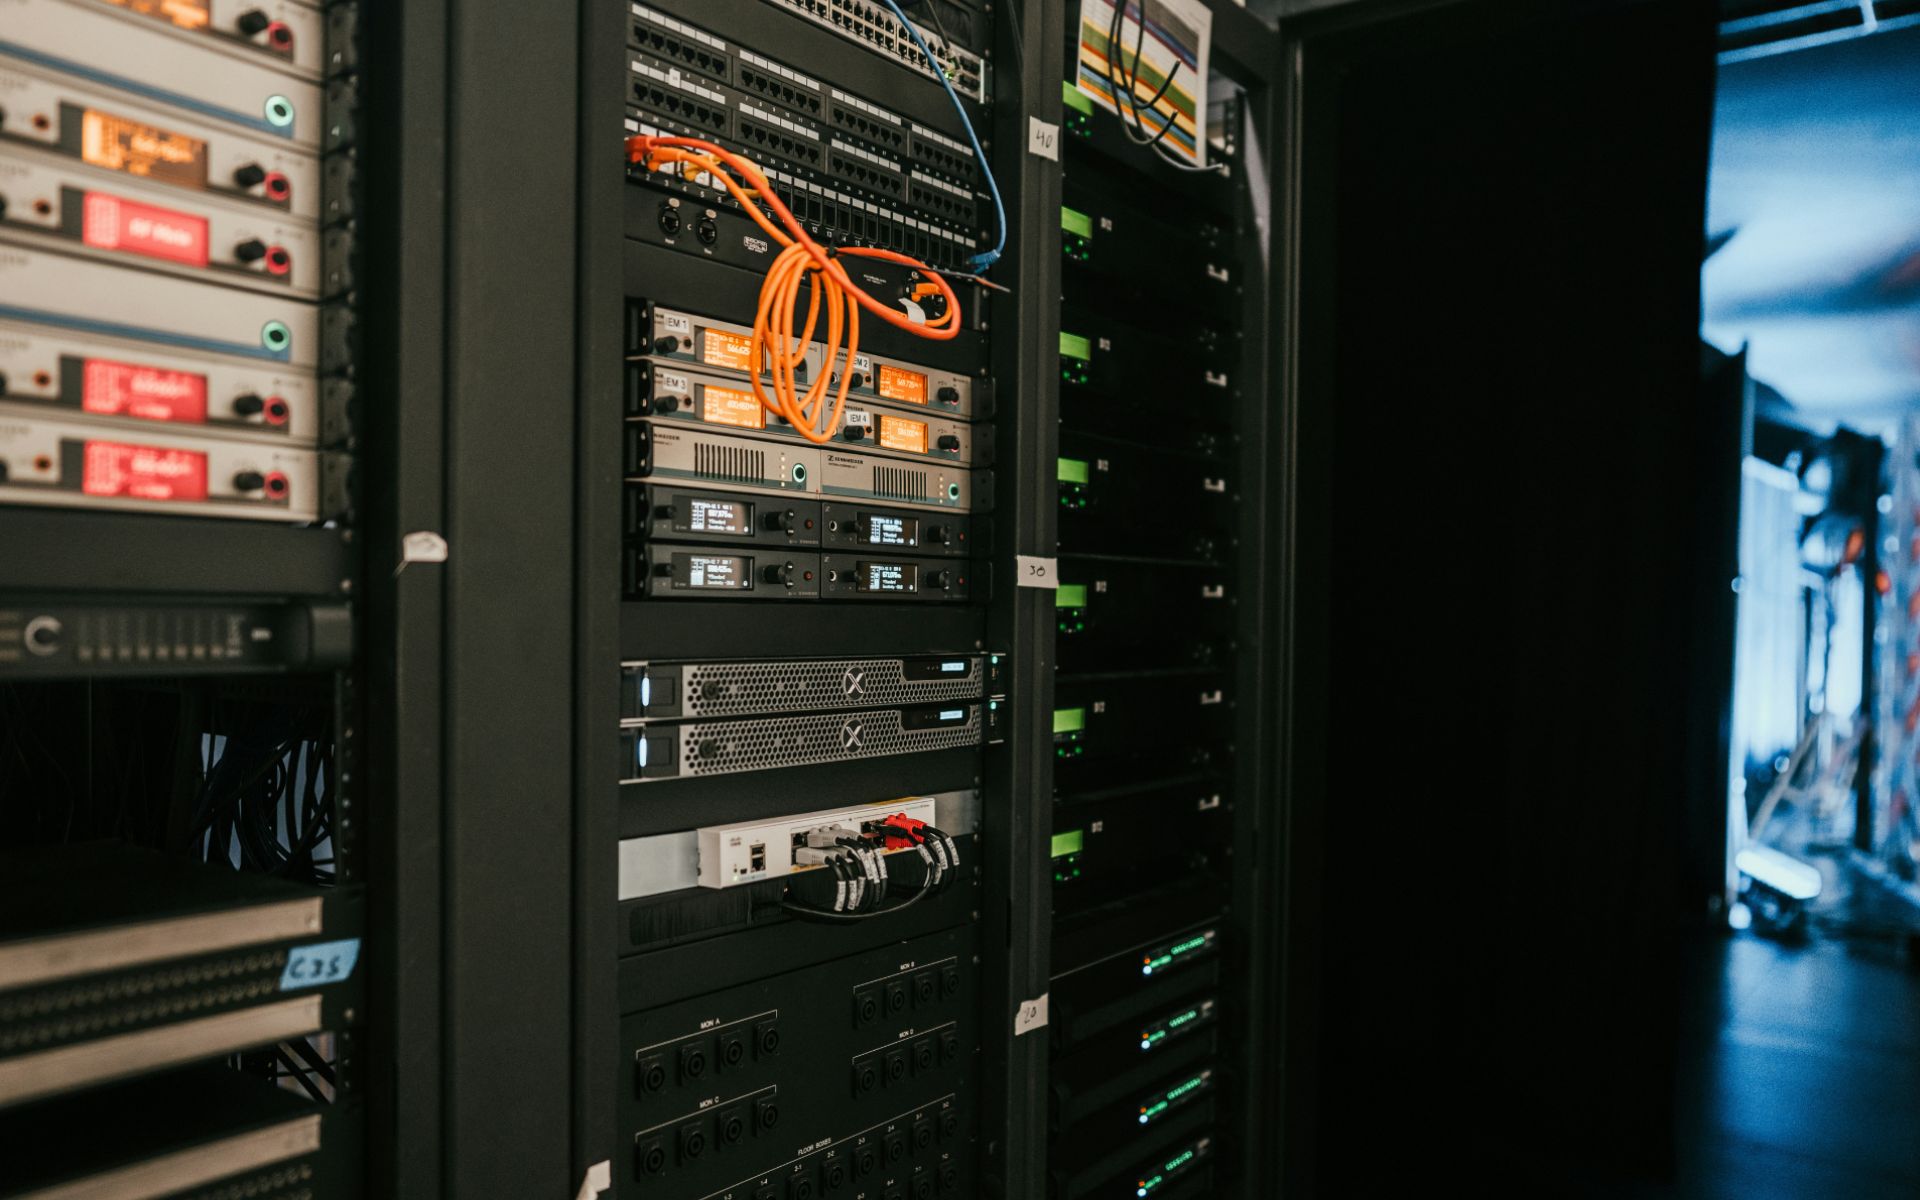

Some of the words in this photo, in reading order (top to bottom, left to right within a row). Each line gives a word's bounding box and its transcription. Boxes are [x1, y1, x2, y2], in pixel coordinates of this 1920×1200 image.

[1035, 129, 1054, 148] 40
[863, 360, 868, 368] 2
[850, 414, 862, 422] IEM
[1030, 564, 1046, 577] 30
[1024, 1006, 1037, 1024] 20
[700, 1020, 714, 1029] MON
[700, 1098, 713, 1108] MON
[797, 1144, 814, 1156] FLOOR
